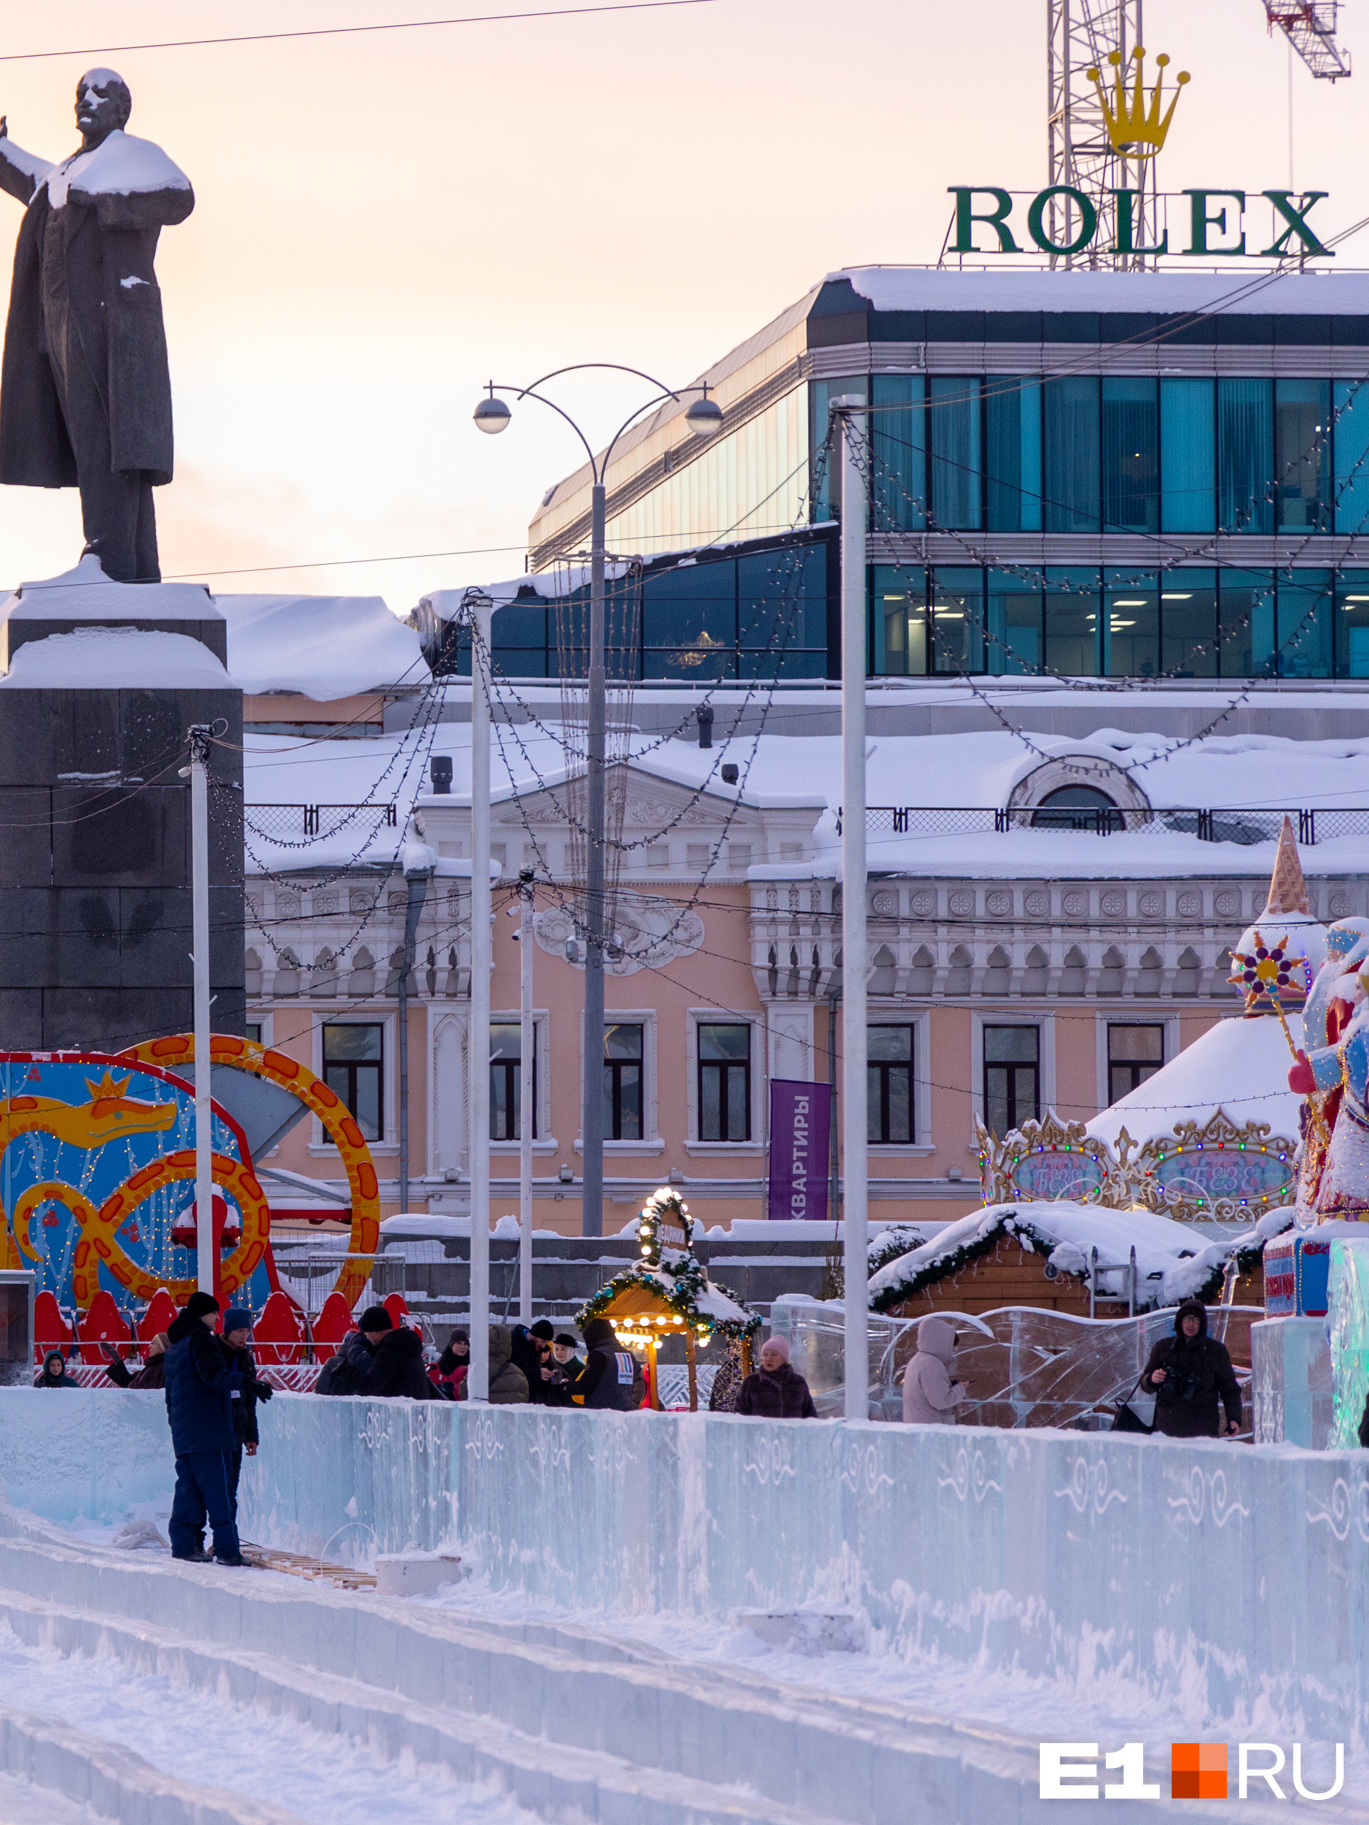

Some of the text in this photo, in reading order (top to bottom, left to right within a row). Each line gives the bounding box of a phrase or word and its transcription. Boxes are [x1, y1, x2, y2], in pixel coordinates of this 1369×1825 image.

[947, 185, 1336, 257] ROLEX
[791, 1095, 810, 1220] КВАРТИРЫ
[1035, 1167, 1081, 1193] БЕЗЕ
[1188, 1165, 1259, 1192] БЕЗЕ
